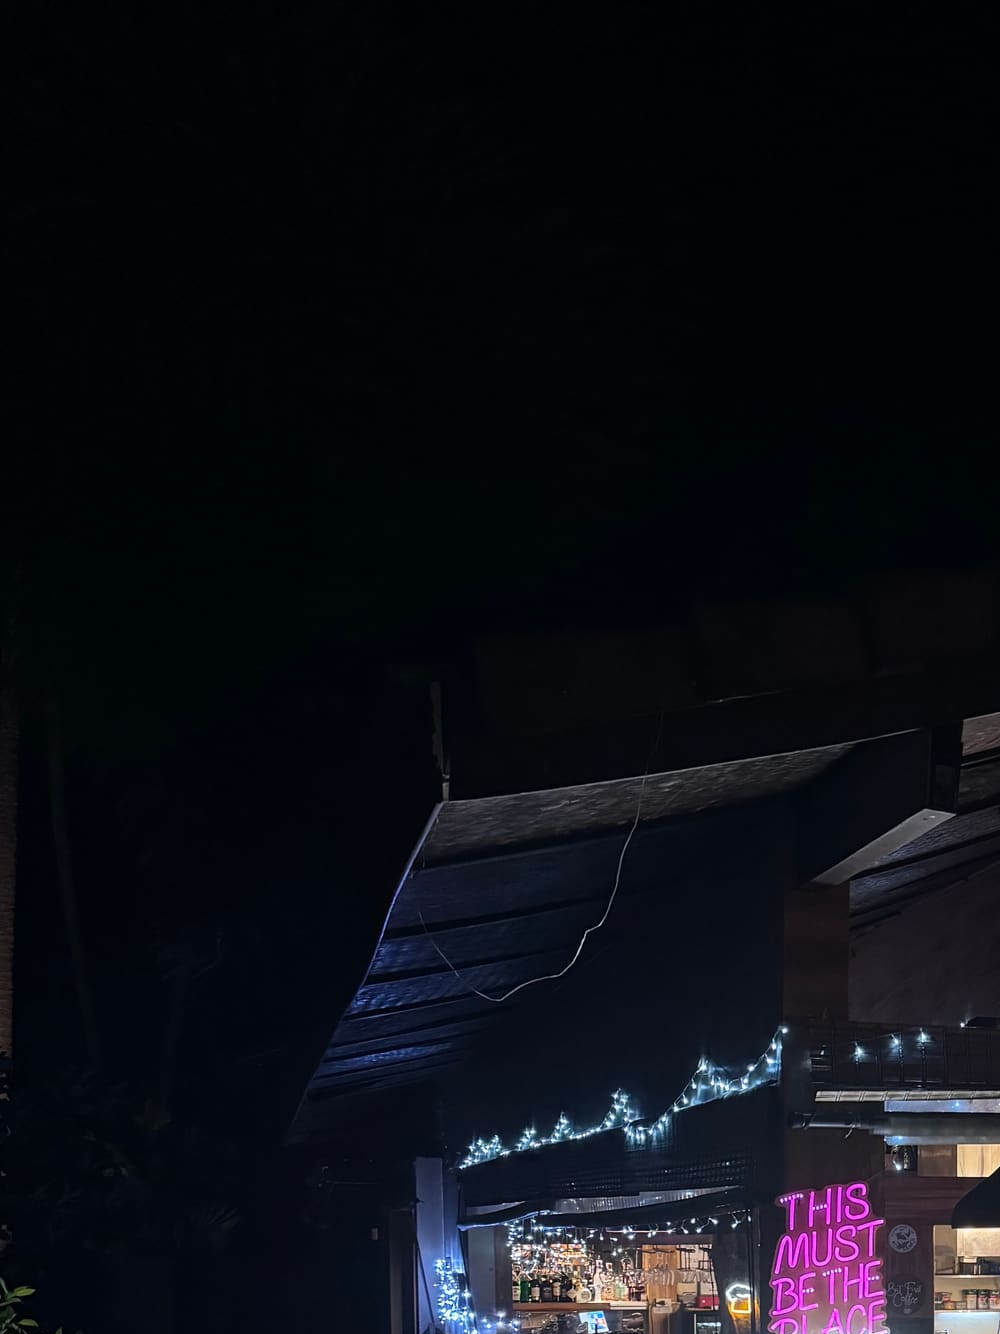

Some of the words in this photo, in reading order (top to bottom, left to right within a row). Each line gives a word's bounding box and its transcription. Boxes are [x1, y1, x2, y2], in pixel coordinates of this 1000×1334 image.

[780, 1183, 870, 1231] THIS
[775, 1219, 884, 1274] MUST
[772, 1273, 818, 1315] BE
[822, 1260, 884, 1304] THE
